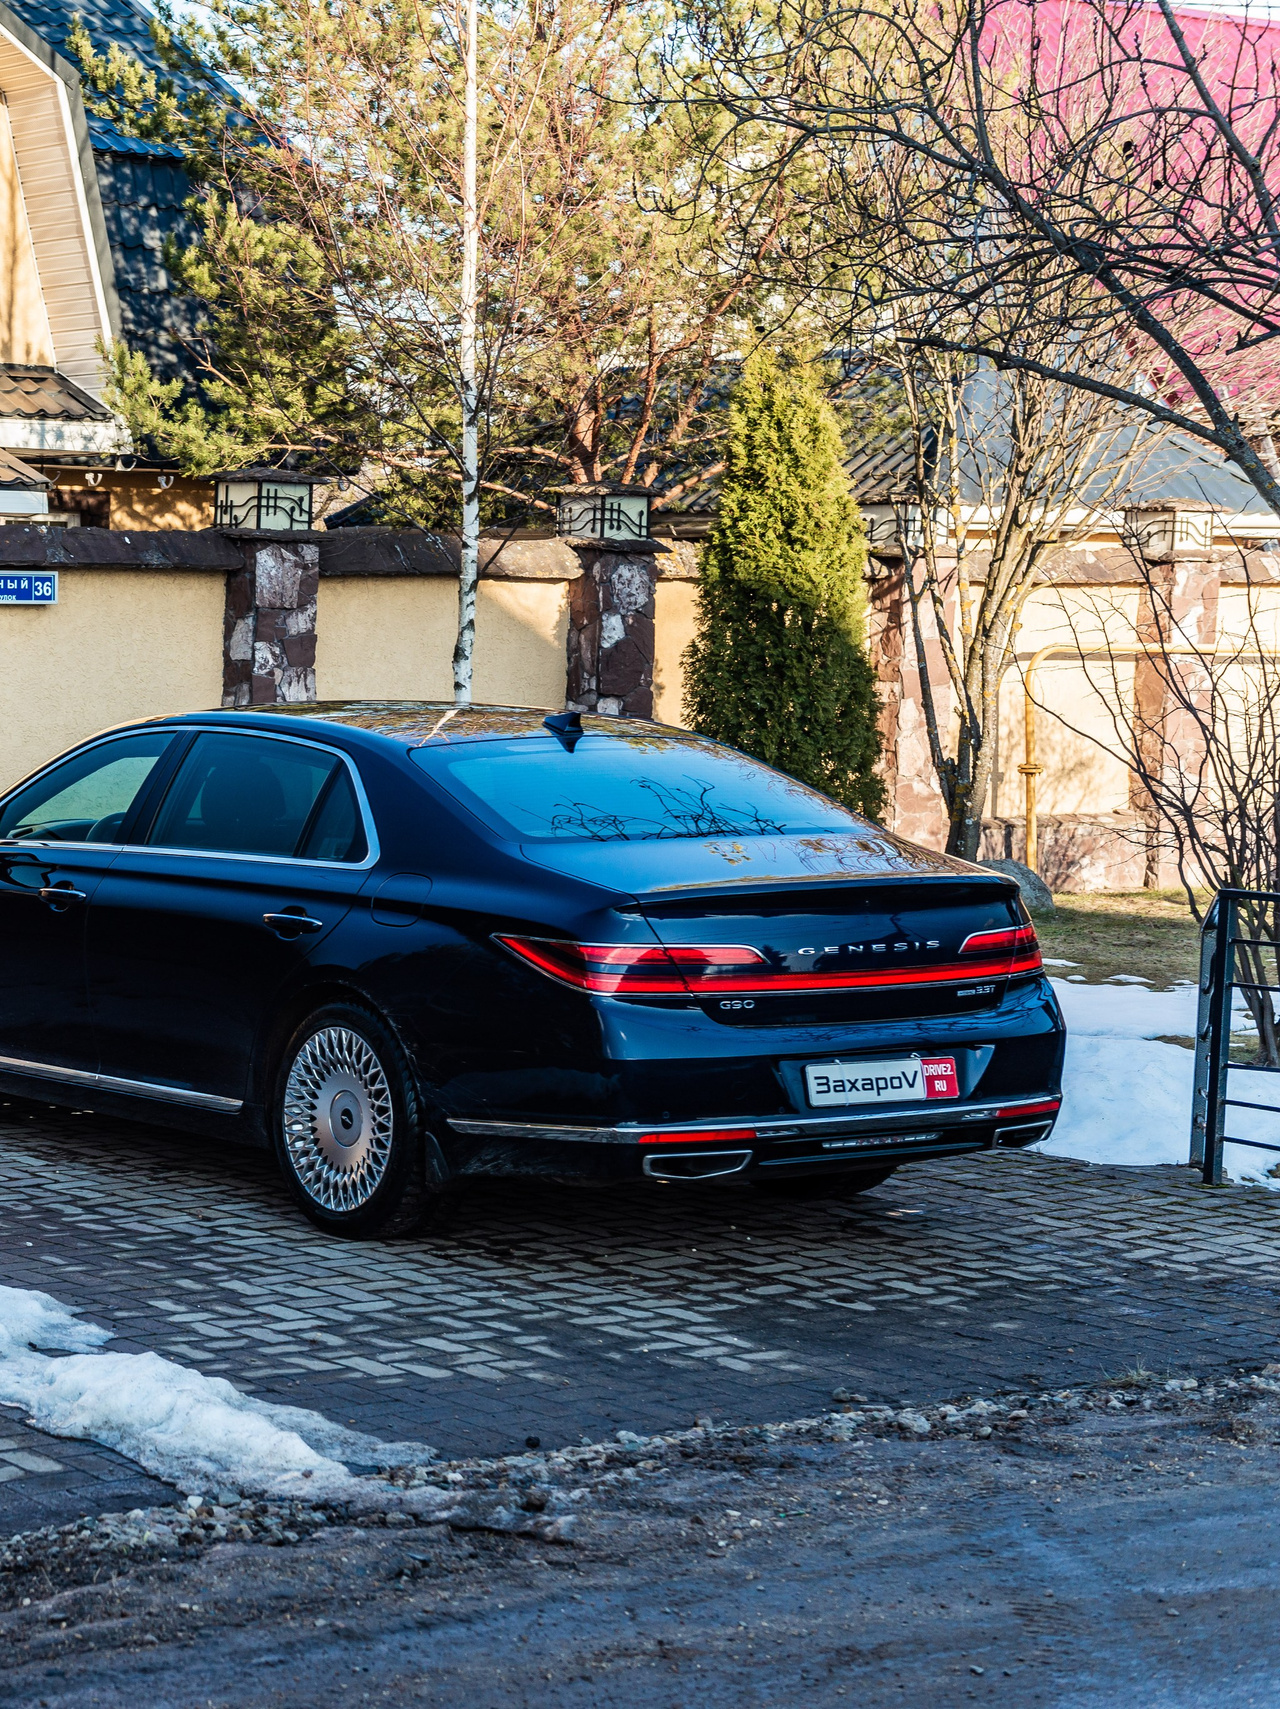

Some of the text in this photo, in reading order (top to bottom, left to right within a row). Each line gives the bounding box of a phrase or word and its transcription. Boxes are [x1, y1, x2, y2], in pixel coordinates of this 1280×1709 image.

[34, 581, 52, 596] 36
[797, 940, 940, 956] GENESIS
[934, 1080, 947, 1092] RU
